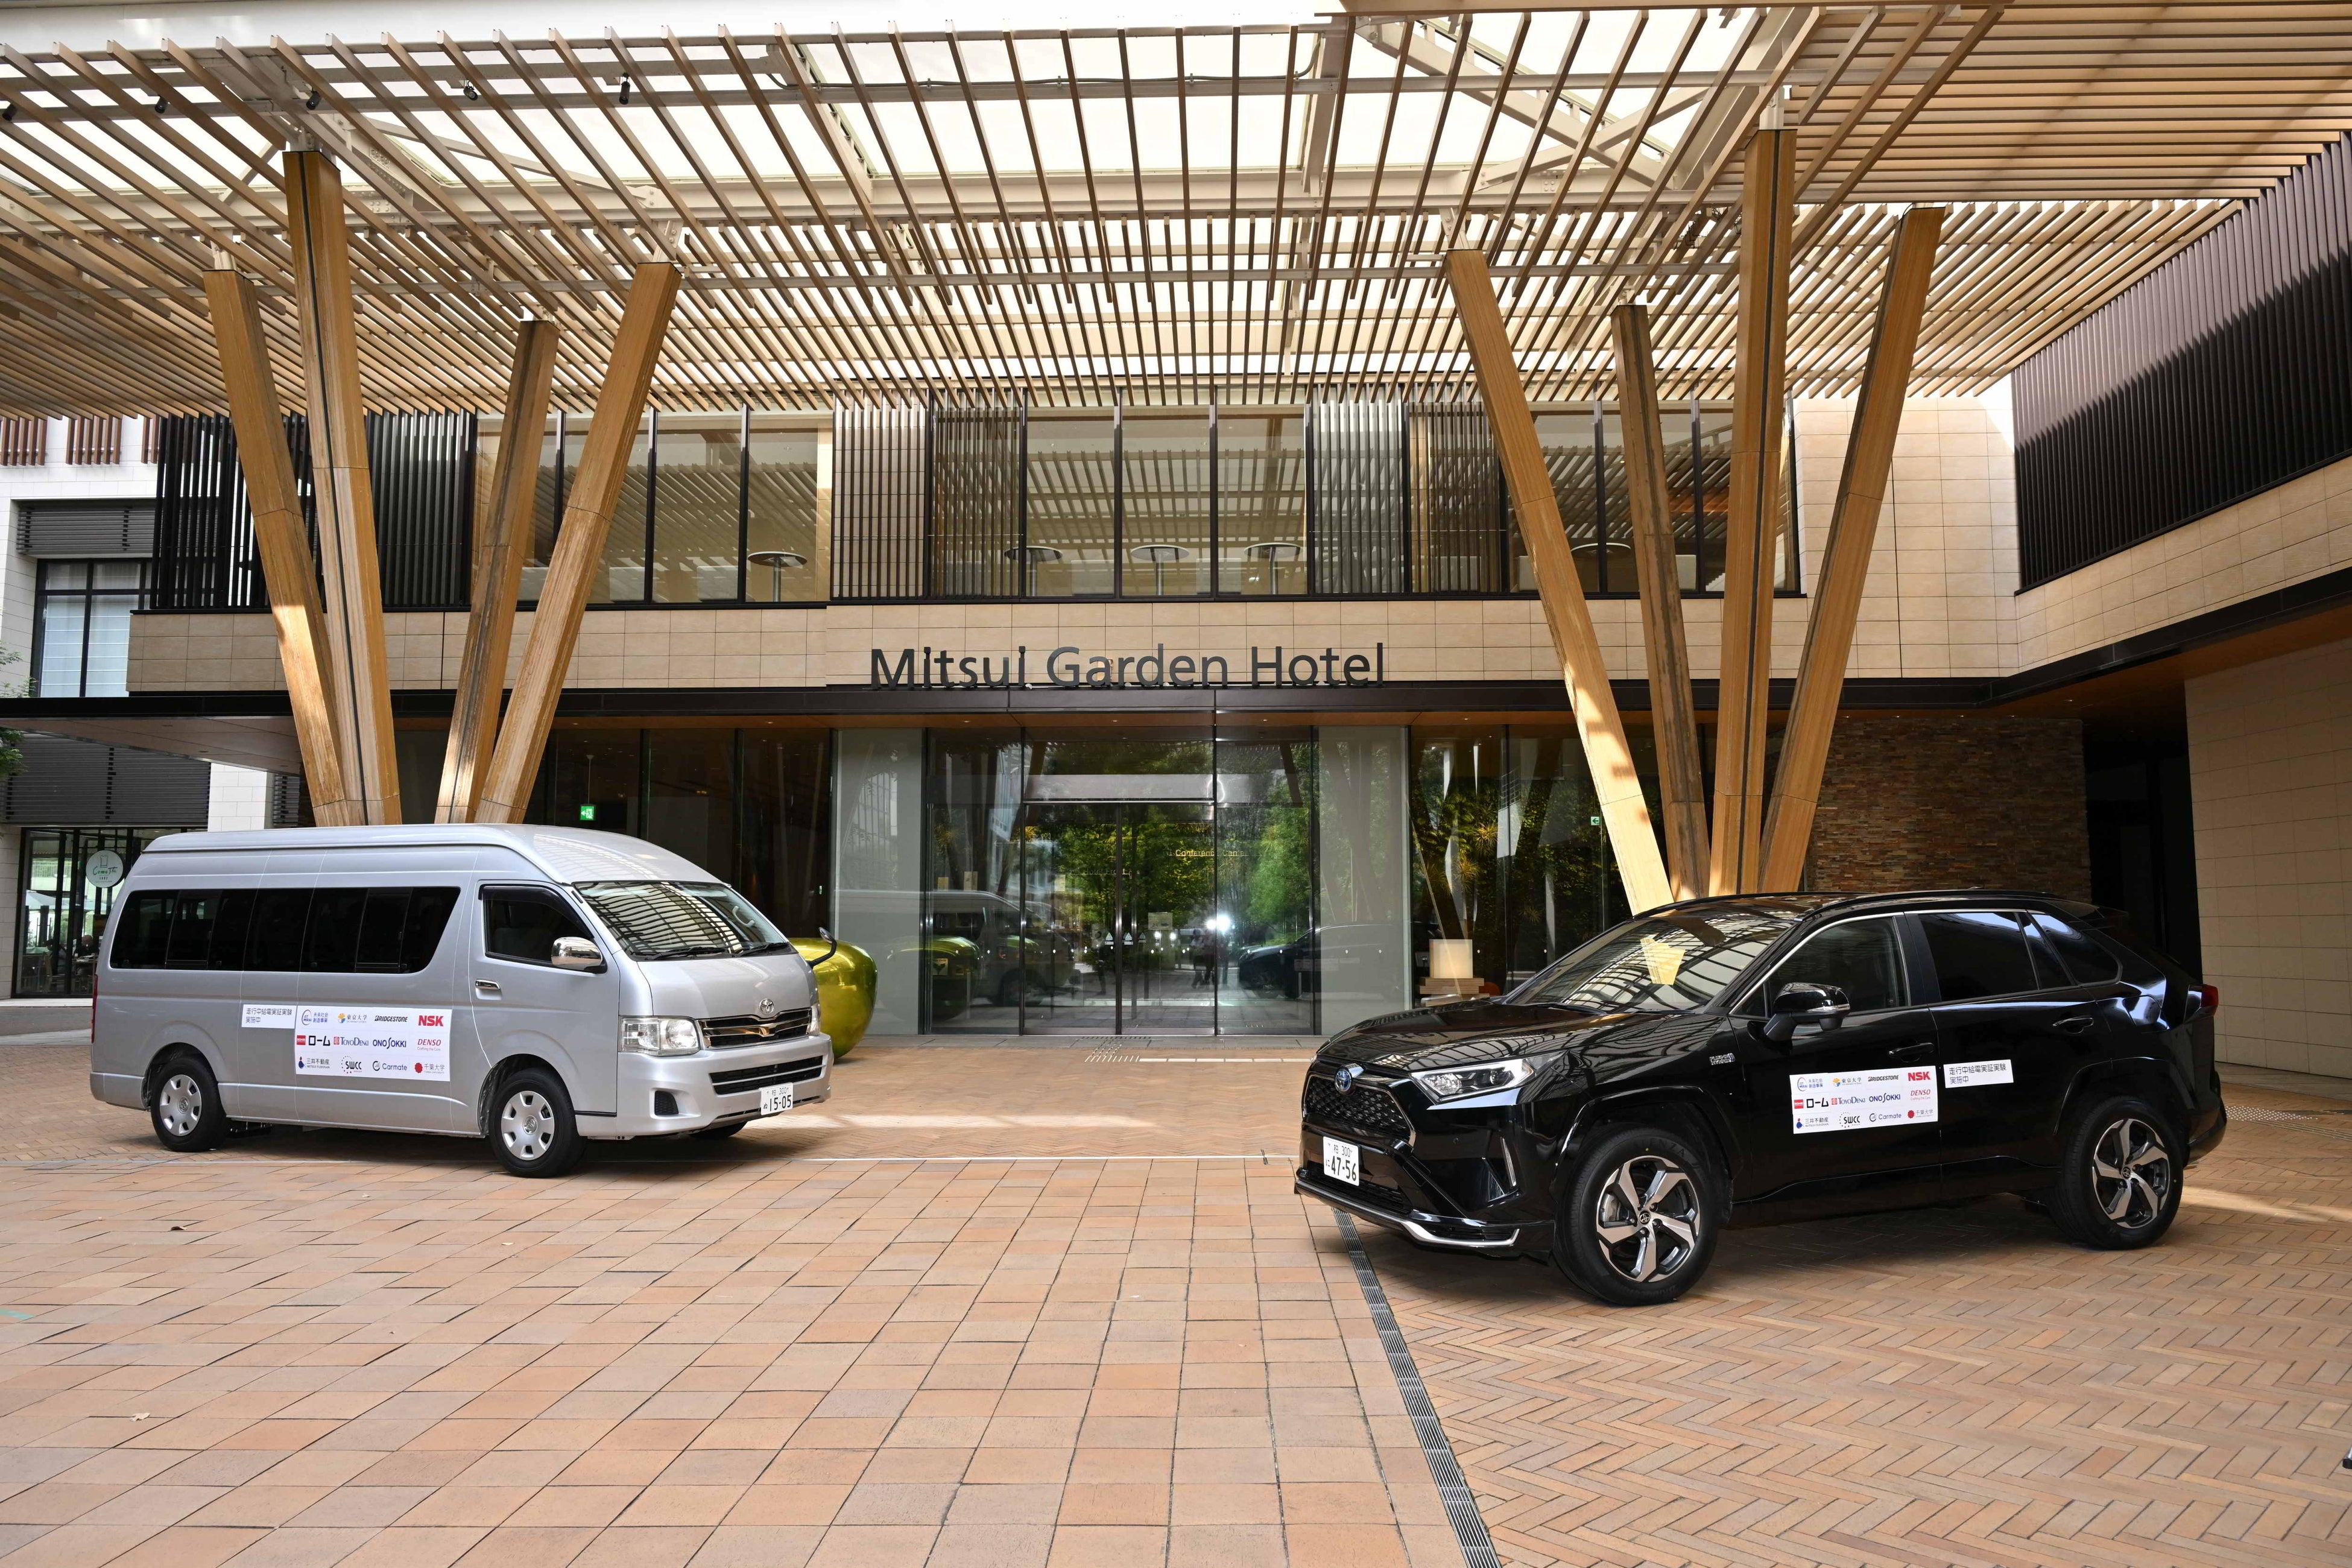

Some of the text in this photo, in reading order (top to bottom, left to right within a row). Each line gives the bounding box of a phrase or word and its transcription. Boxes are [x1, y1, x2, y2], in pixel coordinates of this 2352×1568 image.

[871, 642, 1383, 688] Mitsui Garden Hotel
[418, 1015, 444, 1026] NSK
[308, 1035, 330, 1046] ローム
[346, 1061, 362, 1070] SWCC
[382, 1063, 408, 1071] Carmate
[1949, 1063, 2006, 1075] 走行中給電実証実験
[1908, 1071, 1931, 1081] NSK
[1950, 1076, 1969, 1084] 実施中
[779, 1087, 787, 1095] 300
[770, 1095, 791, 1111] 15-05
[1806, 1098, 1829, 1108] ローム
[1844, 1116, 1860, 1124] SWCC
[1342, 1145, 1350, 1158] 300
[1326, 1155, 1356, 1181] に 47-56
